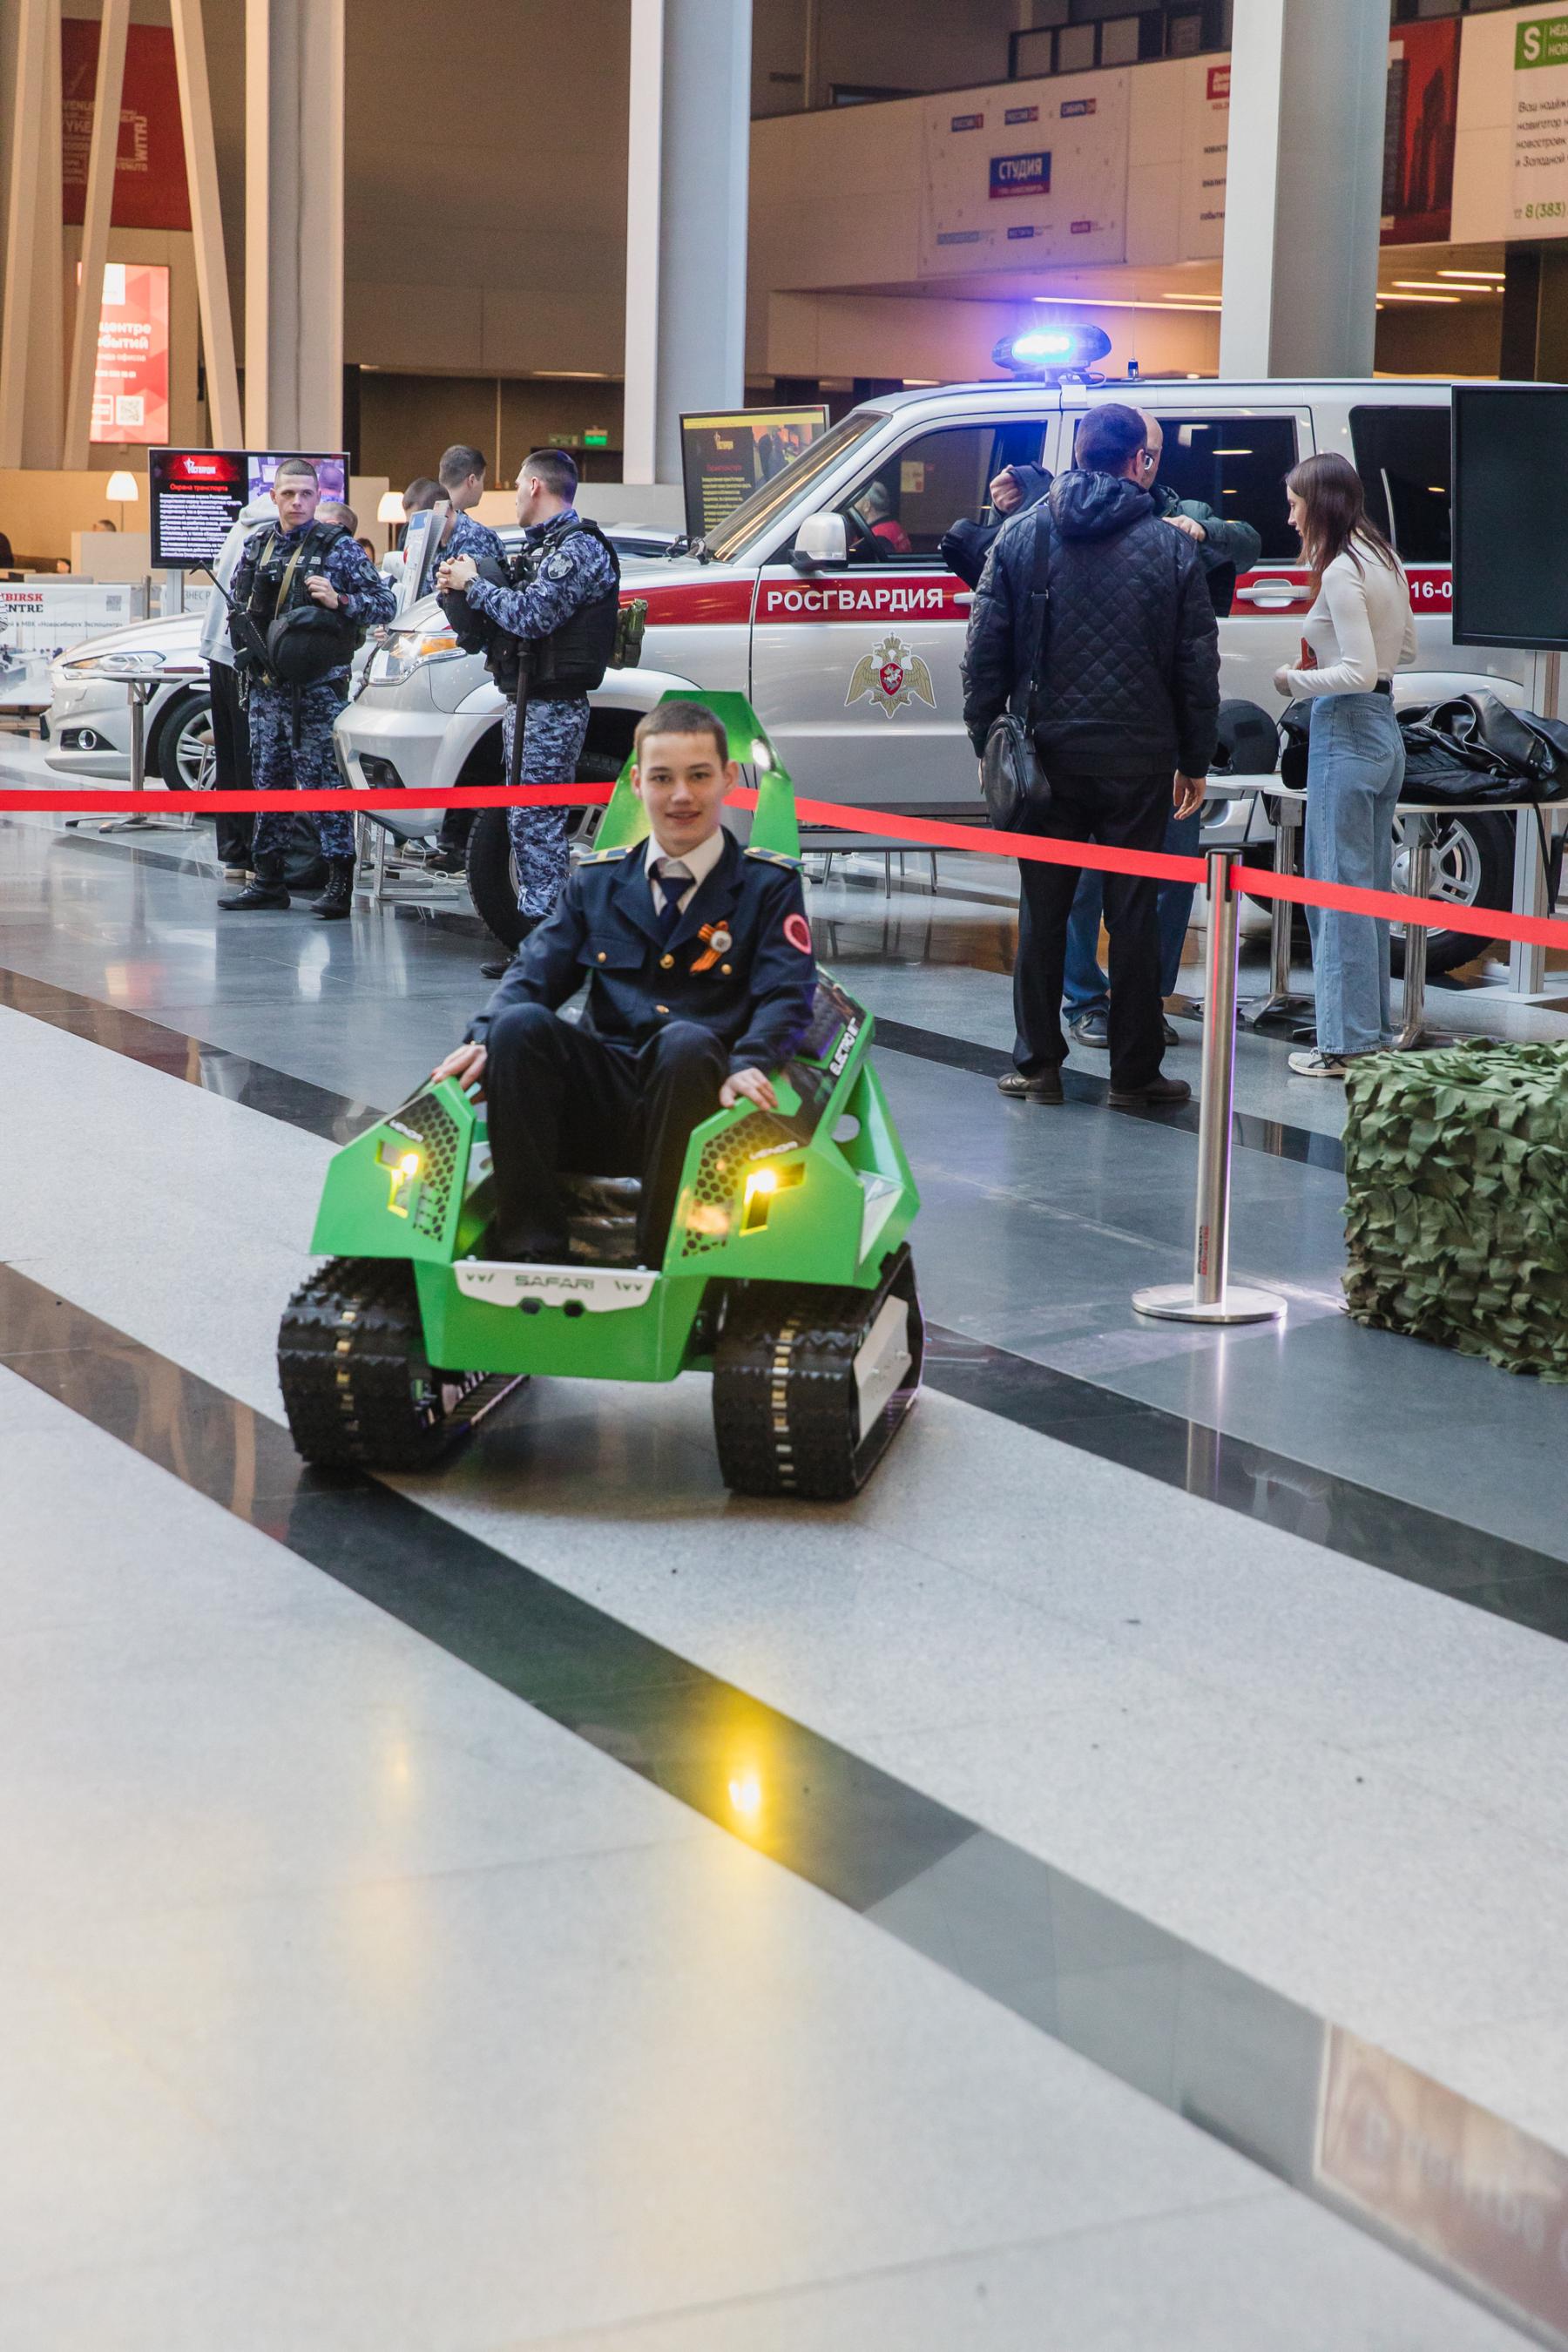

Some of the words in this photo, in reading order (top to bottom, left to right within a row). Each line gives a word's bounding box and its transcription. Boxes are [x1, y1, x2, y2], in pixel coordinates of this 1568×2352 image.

[1524, 26, 1541, 60] S
[998, 158, 1043, 180] СТУДИЯ
[1525, 203, 1533, 219] 8
[767, 588, 943, 612] РОСГВАРДИЯ
[515, 1274, 595, 1291] SAFARI
